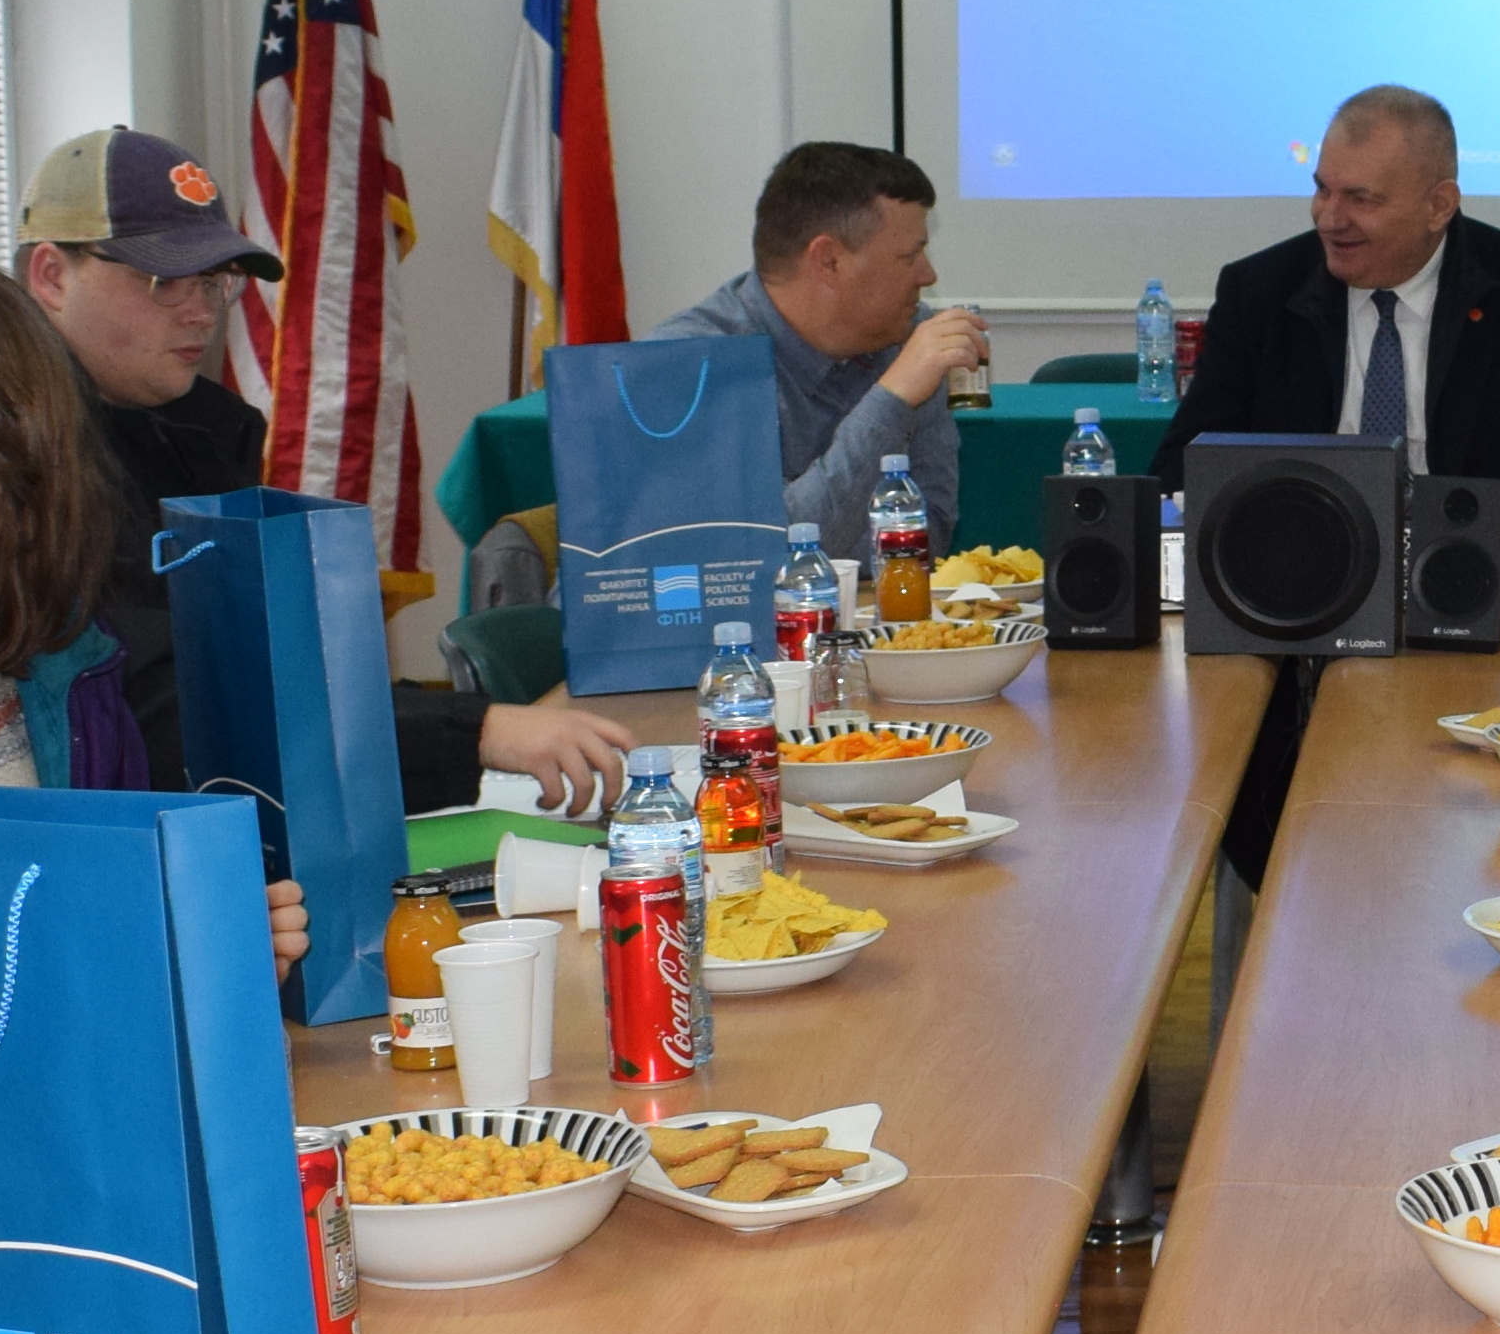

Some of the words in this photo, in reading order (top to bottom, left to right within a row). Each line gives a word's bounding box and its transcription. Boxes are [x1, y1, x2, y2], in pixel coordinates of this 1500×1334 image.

[657, 611, 702, 626] ФПН
[1080, 626, 1107, 634] Logitech
[1443, 627, 1471, 636] Logitech
[1349, 639, 1386, 650] Logitech
[640, 890, 682, 902] ORIGINAL
[656, 914, 694, 1069] Coca-Cola
[412, 1007, 449, 1024] GUSTO
